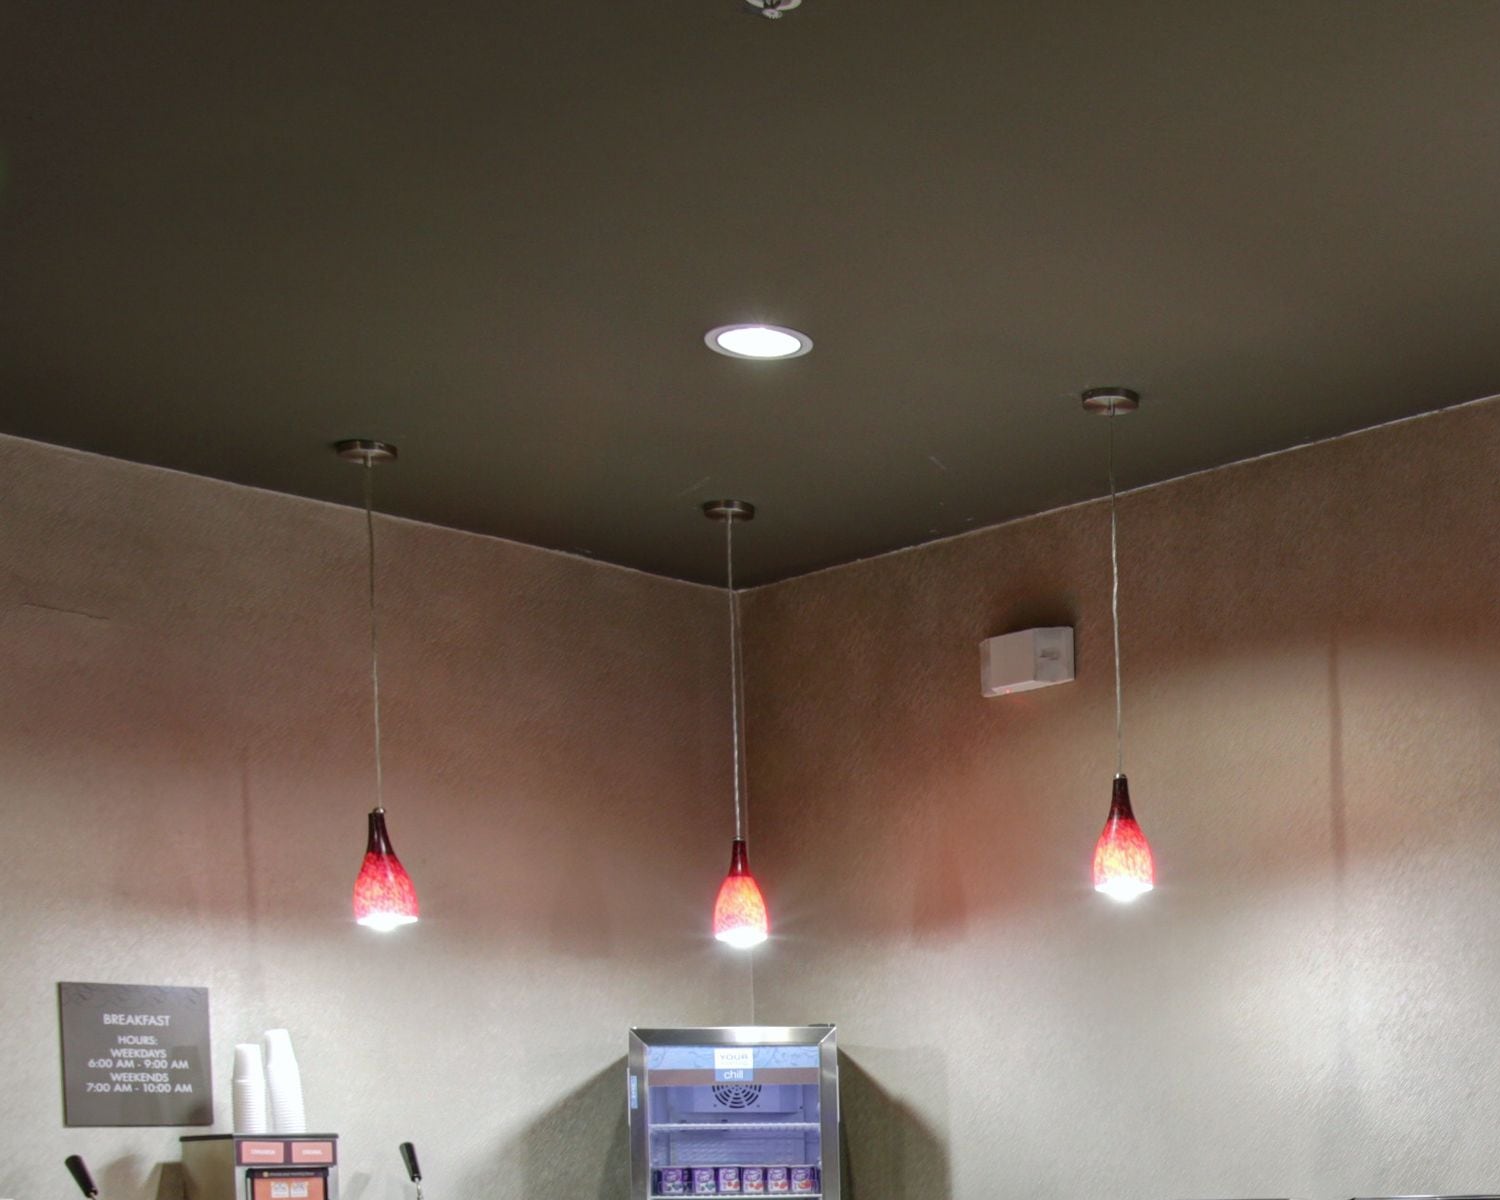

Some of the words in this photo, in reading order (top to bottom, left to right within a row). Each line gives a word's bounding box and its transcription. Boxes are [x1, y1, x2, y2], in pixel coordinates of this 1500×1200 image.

[103, 1014, 171, 1026] BREAKFAST
[117, 1035, 158, 1045] HOURS:
[110, 1048, 167, 1058] WEEKDAYS
[719, 1053, 749, 1061] YOUR
[88, 1059, 113, 1068] 6:00
[115, 1060, 135, 1068] AM
[143, 1060, 168, 1069] 9:00
[170, 1060, 189, 1069] AM
[109, 1072, 169, 1082] WEEKENDS
[723, 1069, 744, 1080] chill
[86, 1083, 111, 1092] 7:00
[113, 1083, 133, 1092] AM
[143, 1083, 172, 1093] 10:00
[174, 1084, 193, 1093] AM
